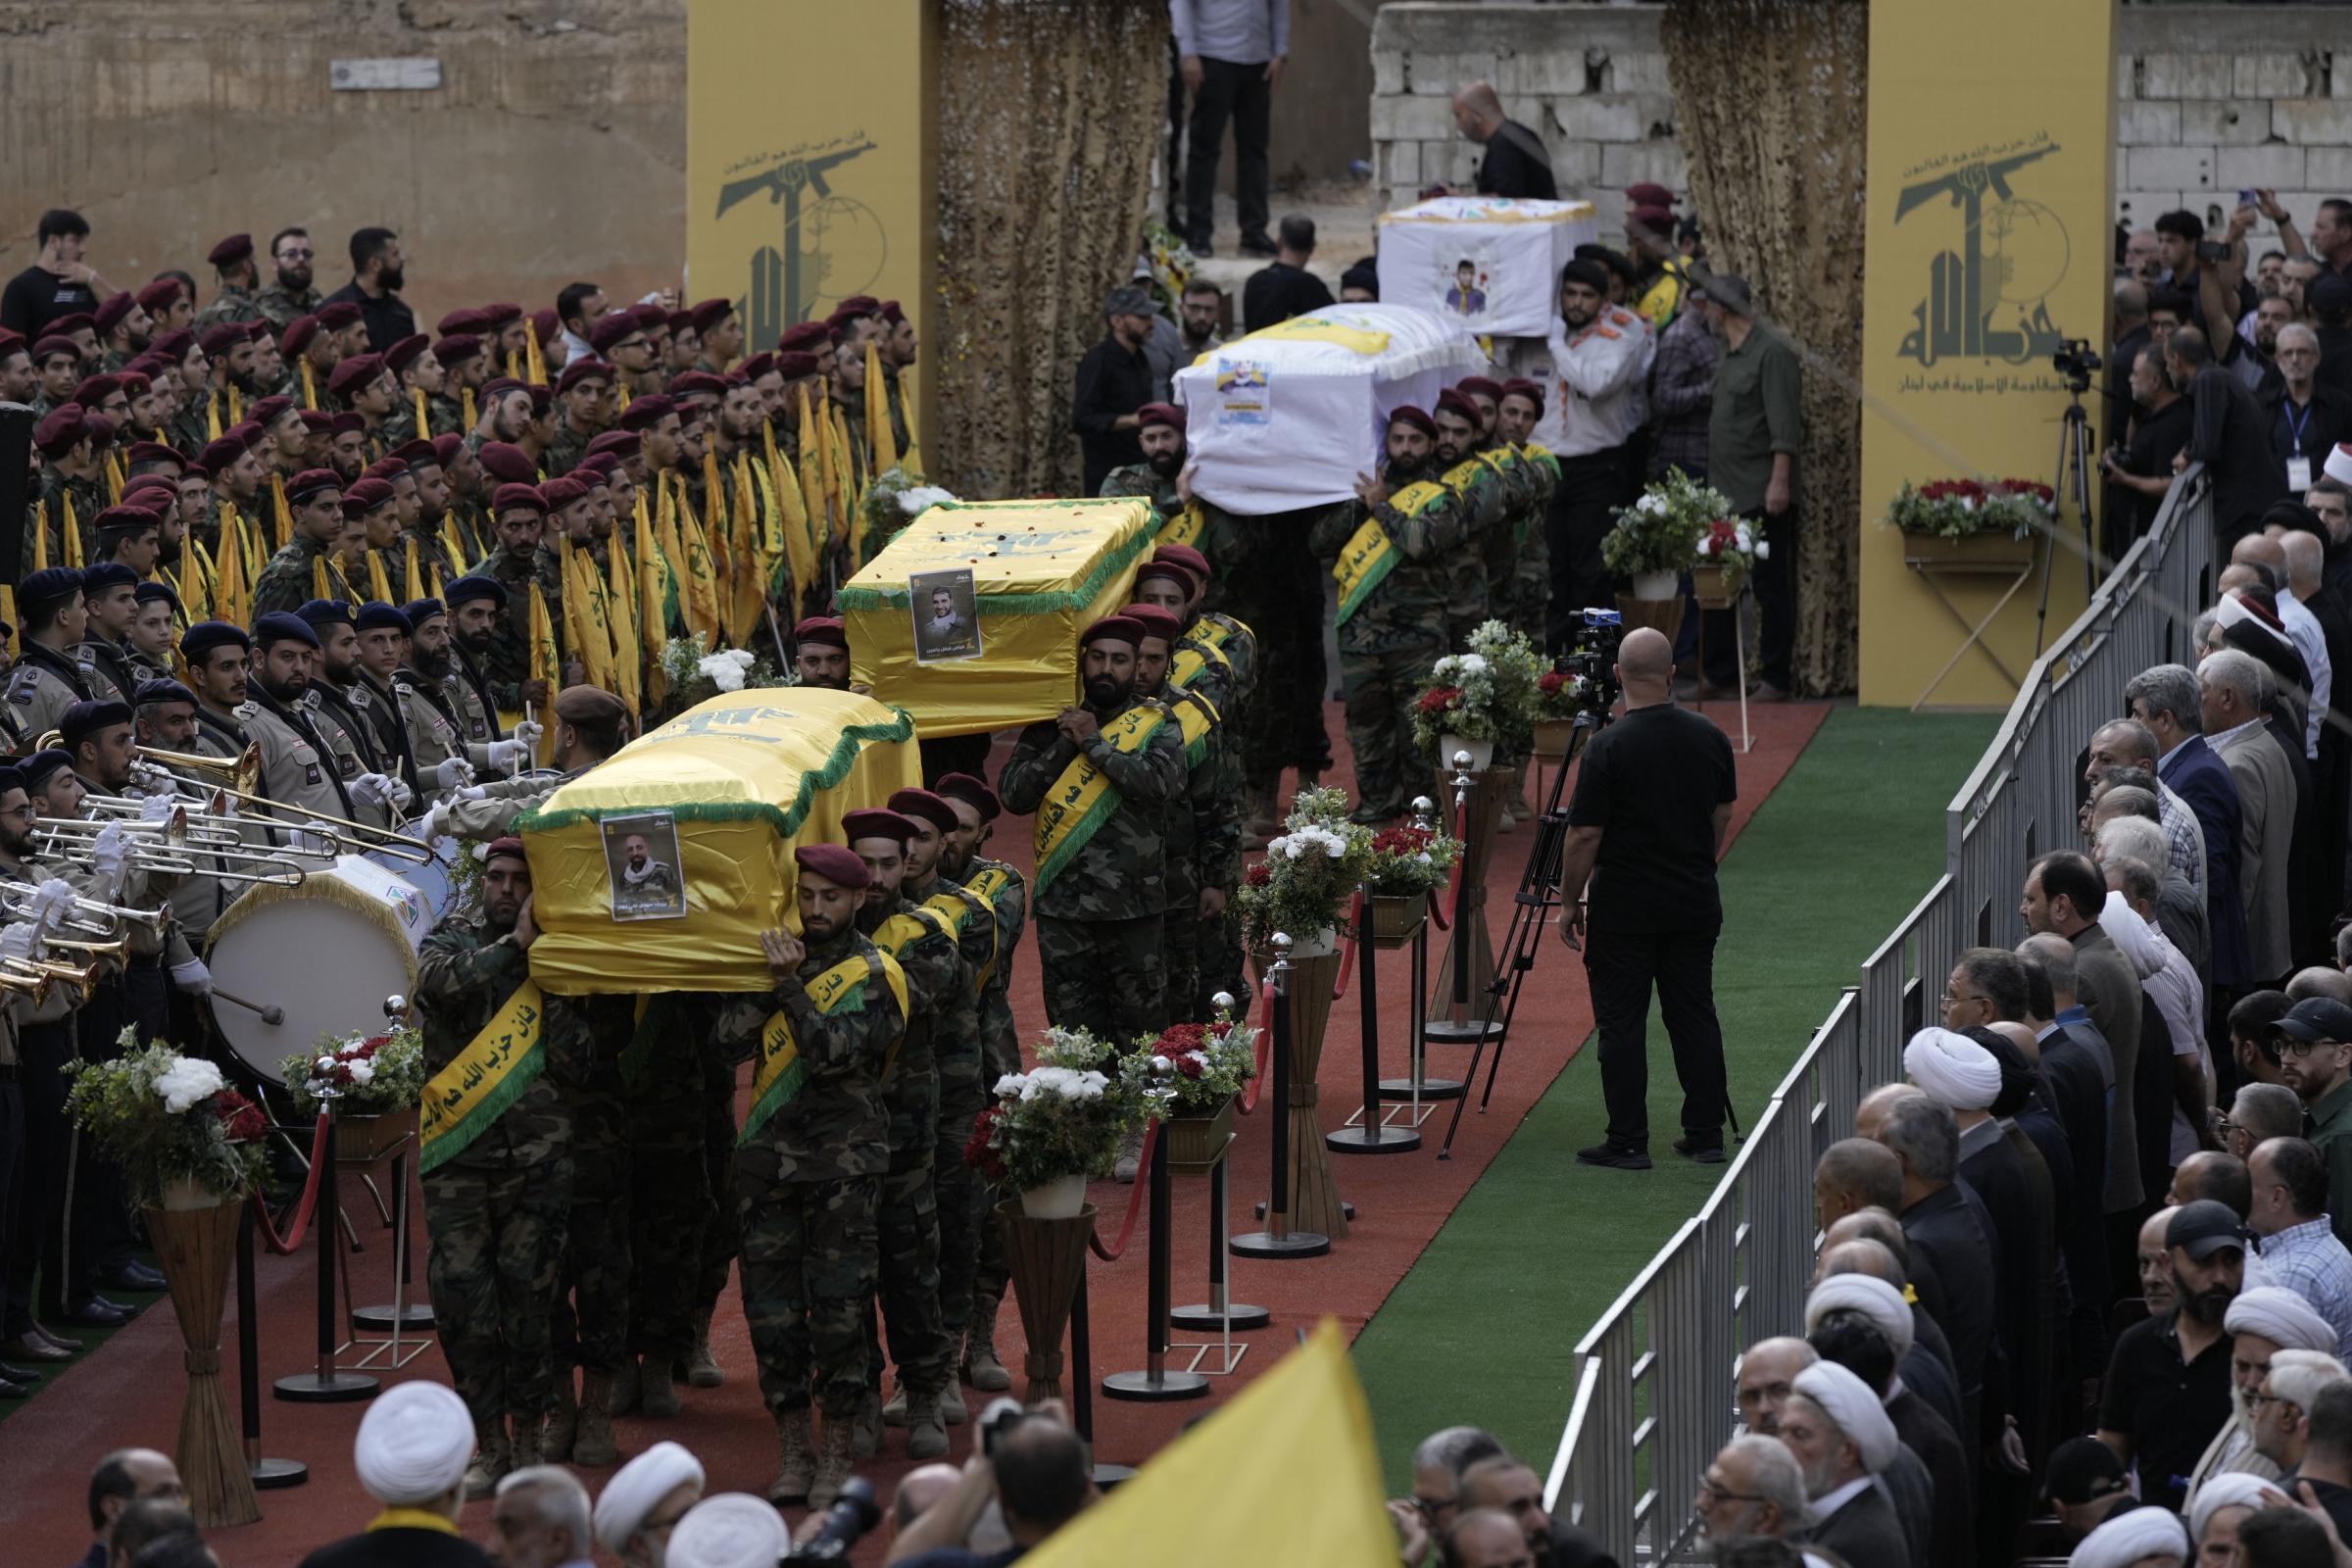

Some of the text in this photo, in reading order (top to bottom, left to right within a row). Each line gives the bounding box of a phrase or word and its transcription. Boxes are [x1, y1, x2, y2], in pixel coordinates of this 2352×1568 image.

[1077, 762, 1098, 786] لله
[483, 1033, 513, 1071] حزب
[767, 1027, 789, 1057] الله
[463, 1061, 486, 1091] الله
[443, 1088, 464, 1116] هم
